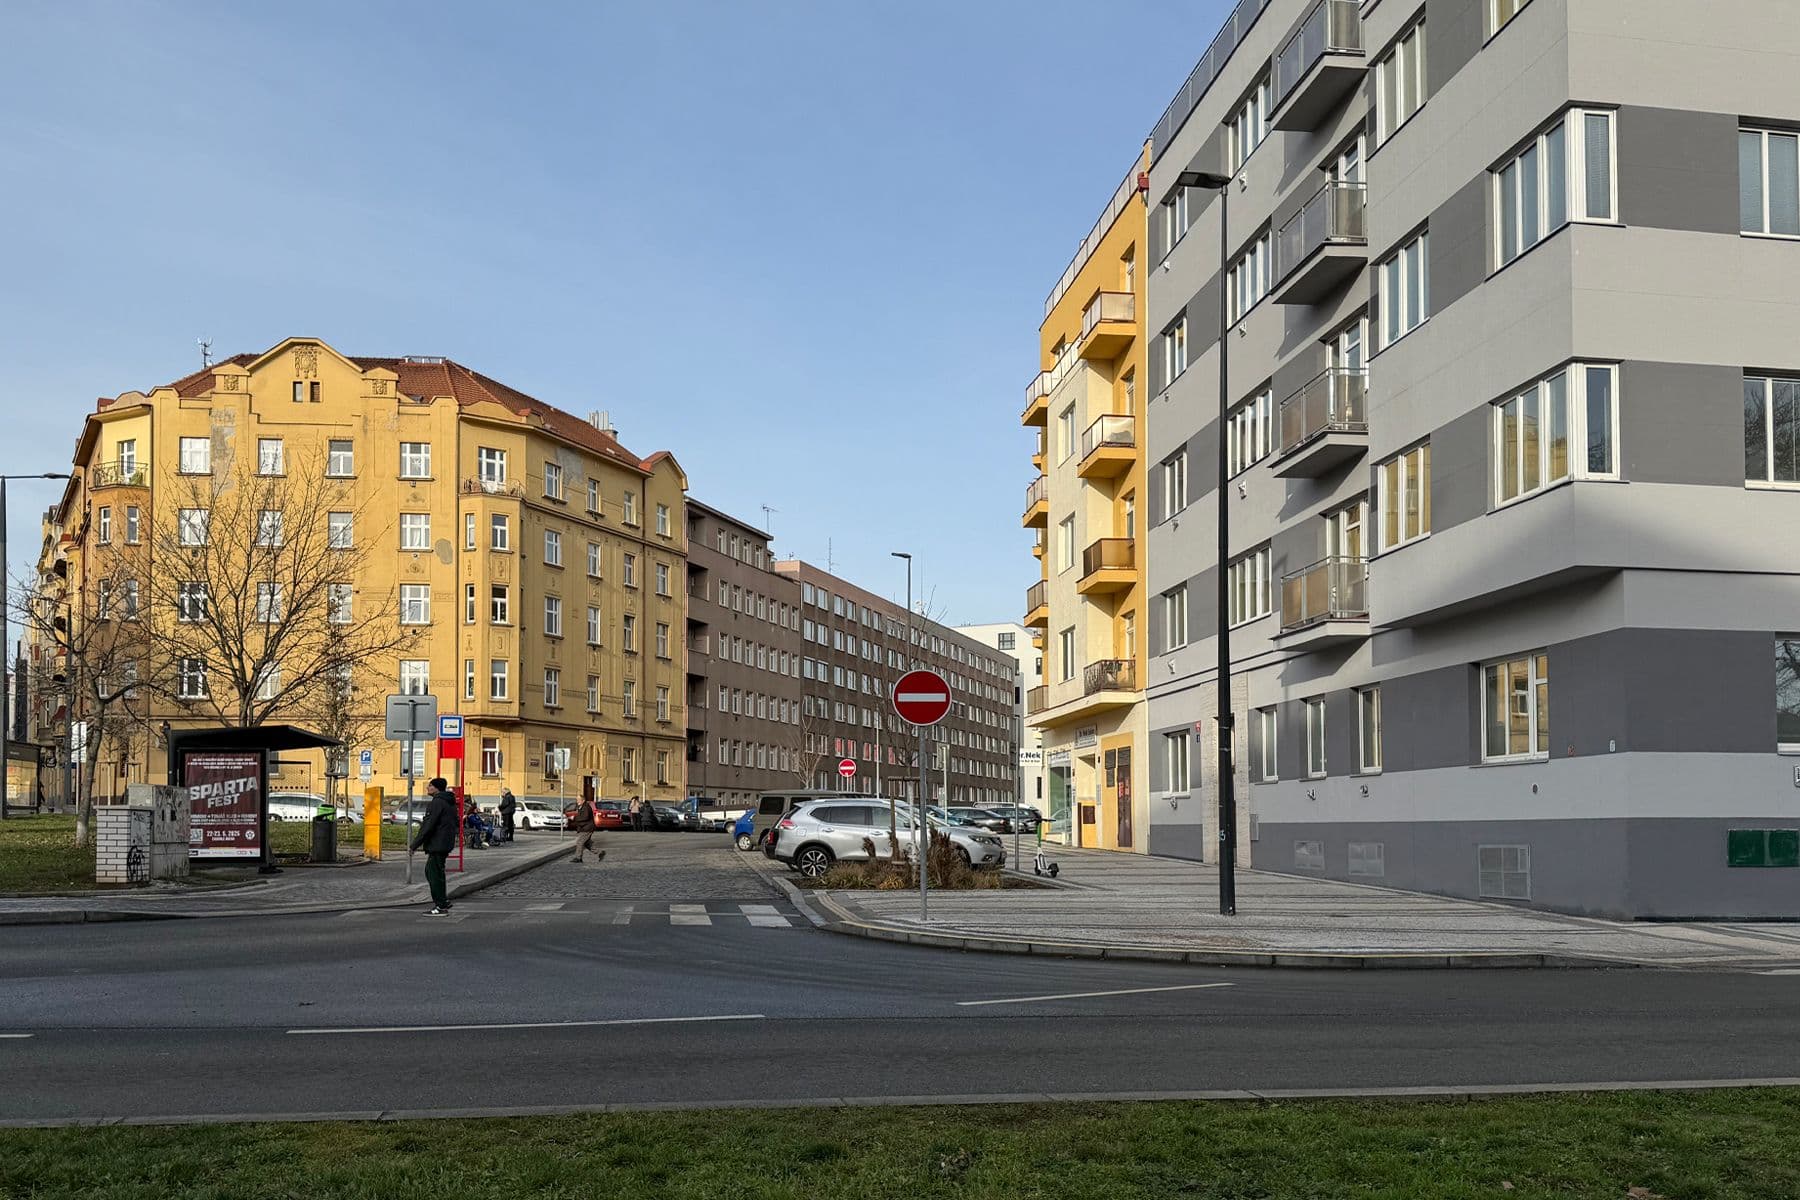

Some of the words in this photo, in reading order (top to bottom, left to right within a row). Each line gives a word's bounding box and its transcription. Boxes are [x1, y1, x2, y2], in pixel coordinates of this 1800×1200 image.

[362, 752, 370, 760] P
[190, 777, 258, 800] SPARTA
[207, 793, 240, 808] FEST
